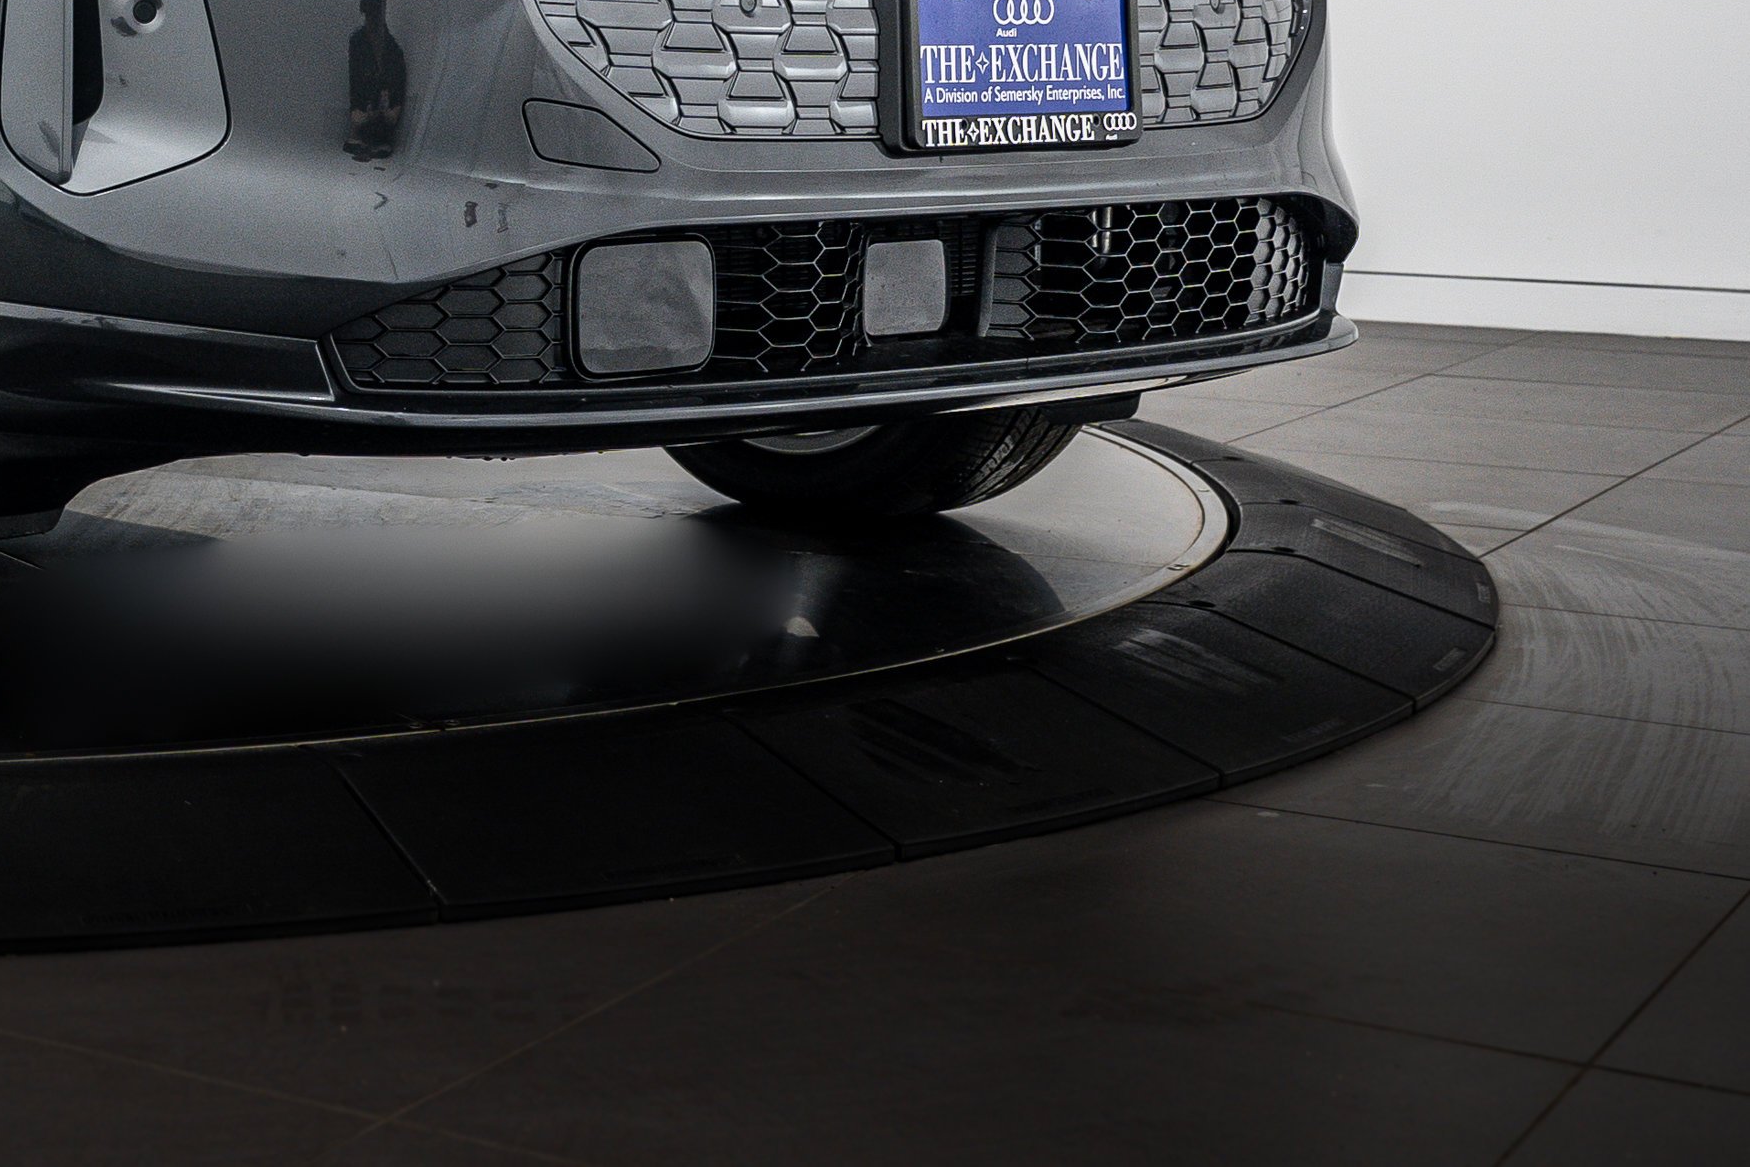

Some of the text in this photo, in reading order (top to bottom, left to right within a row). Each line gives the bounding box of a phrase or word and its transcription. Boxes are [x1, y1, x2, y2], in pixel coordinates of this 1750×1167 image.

[996, 28, 1018, 38] Audi
[920, 43, 1125, 84] THE EXCHANGE
[924, 84, 1126, 106] A Division of Semersky Enterprises, Inc.
[922, 114, 1095, 147] THE EXCHANGE
